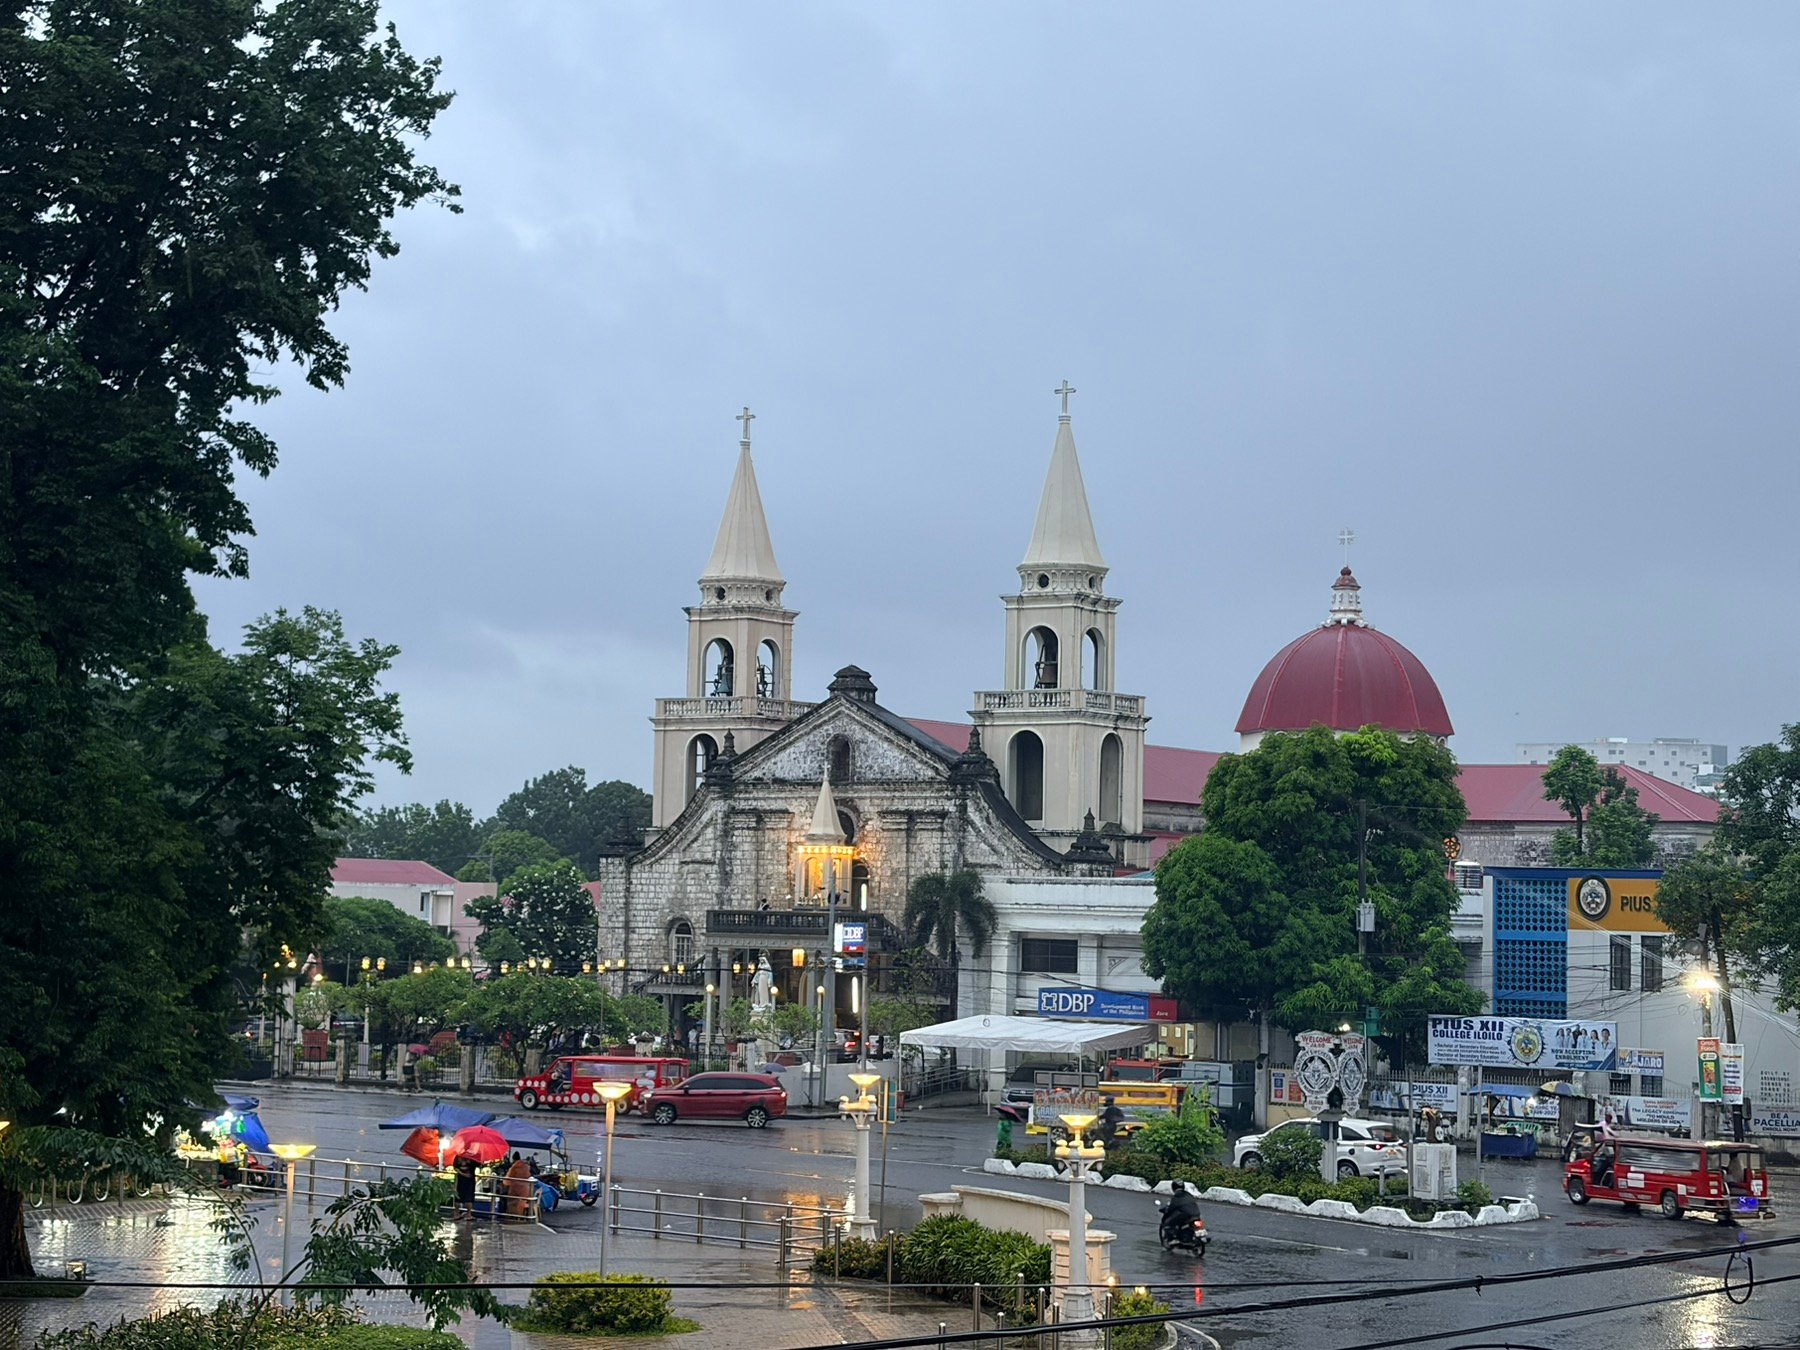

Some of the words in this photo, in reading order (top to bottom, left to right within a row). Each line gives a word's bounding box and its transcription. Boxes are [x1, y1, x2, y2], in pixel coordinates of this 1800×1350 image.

[1620, 896, 1651, 912] PIUS
[849, 927, 864, 938] DBP
[1058, 993, 1095, 1012] DBP
[1432, 1018, 1474, 1030] PIUS
[1480, 1020, 1504, 1032] XII
[1301, 1036, 1332, 1044] WELCOME
[1432, 1029, 1471, 1039] COLLEGE
[1473, 1031, 1502, 1040] ILOILO
[1638, 1057, 1663, 1068] JARO
[1412, 1084, 1433, 1093] PIUS
[1436, 1085, 1448, 1094] XII
[1754, 1119, 1800, 1127] PACELLIA
